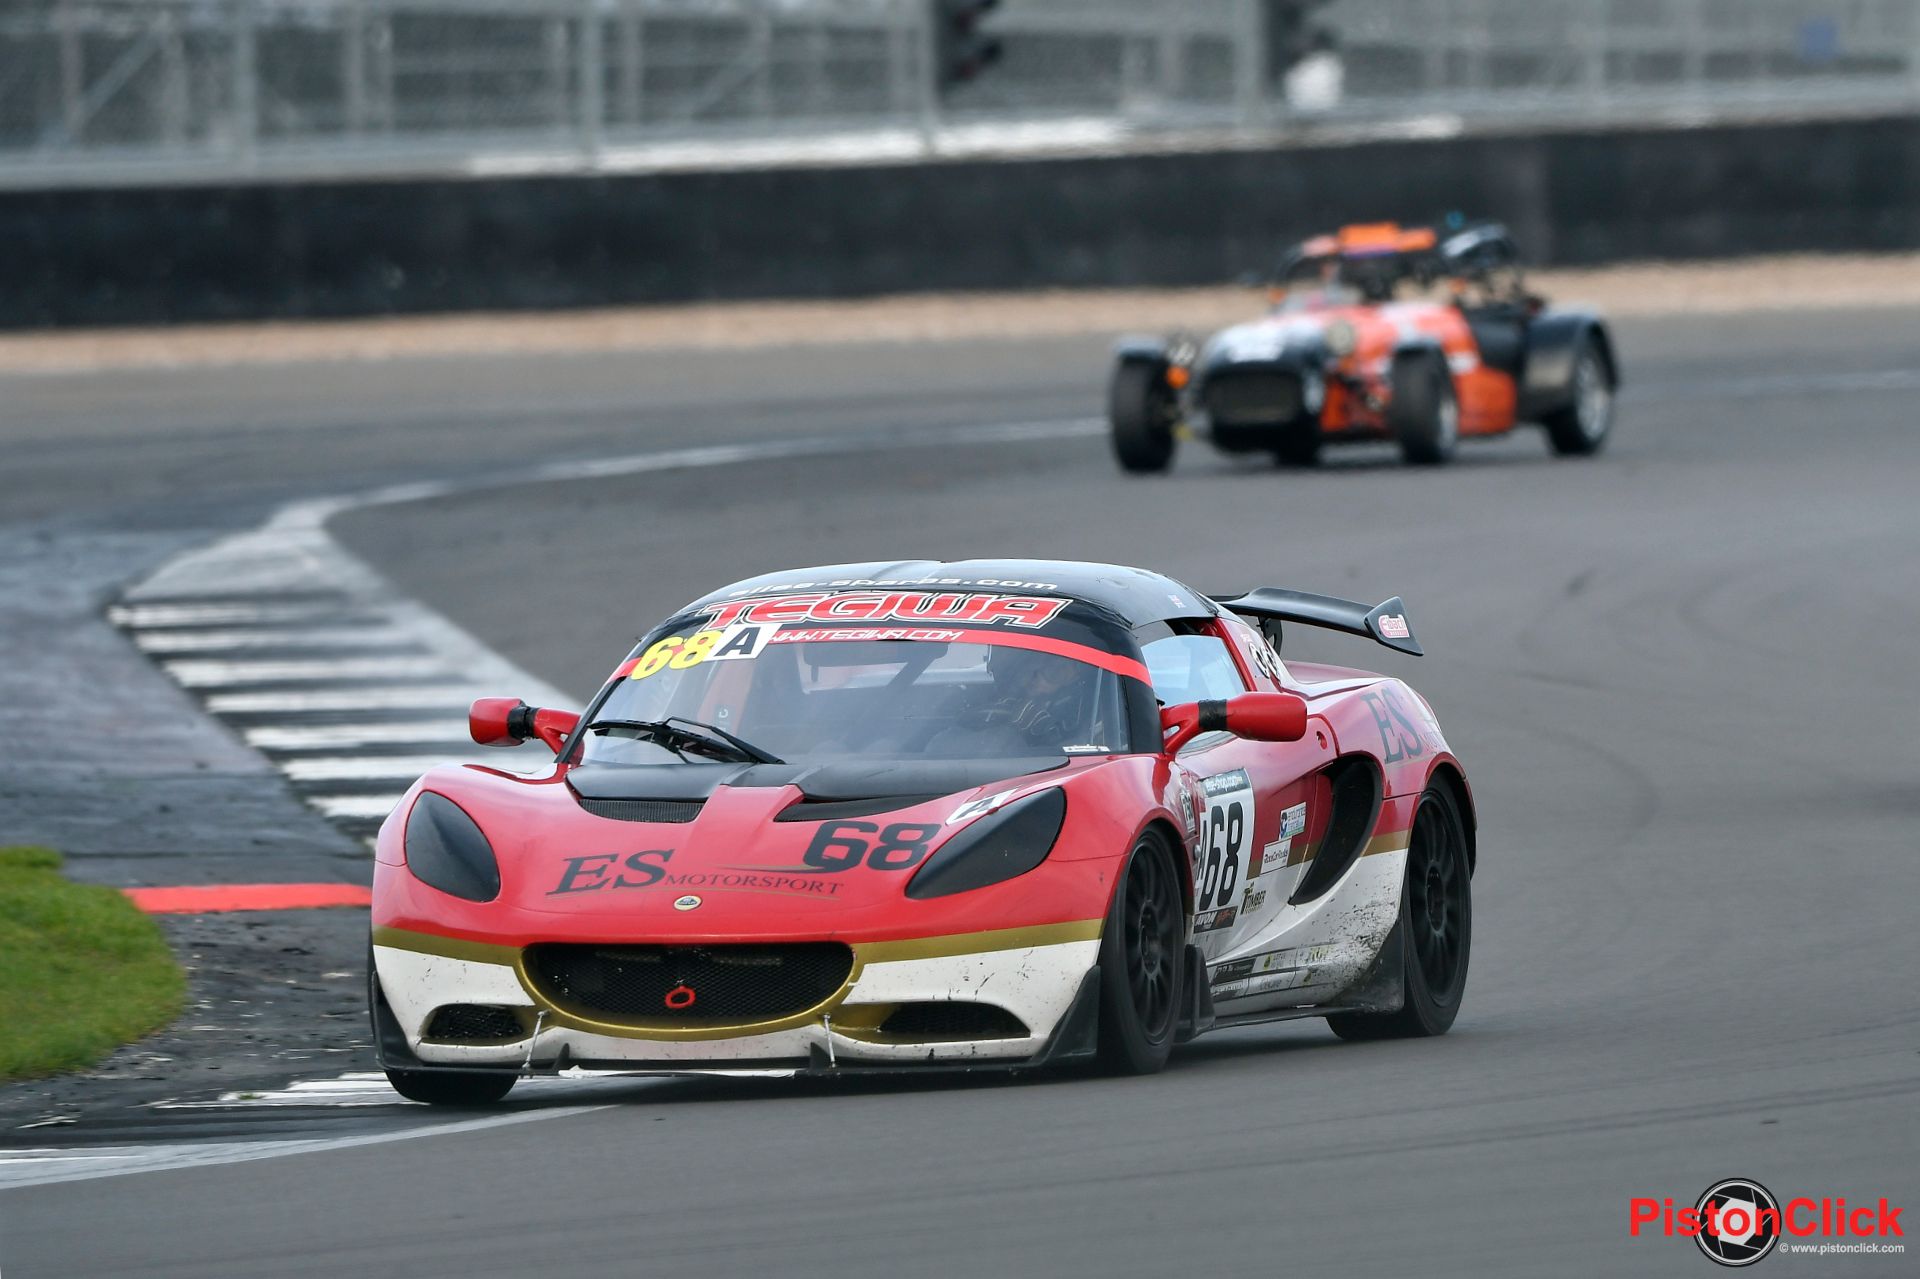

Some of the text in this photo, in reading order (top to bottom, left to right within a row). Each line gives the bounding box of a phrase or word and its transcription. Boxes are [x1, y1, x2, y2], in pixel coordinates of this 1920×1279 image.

[696, 590, 1075, 631] TEGIWA
[630, 626, 761, 680] 68 A
[545, 848, 844, 896] ES MOTORSPORT
[802, 820, 942, 874] 68
[1199, 801, 1244, 911] 68
